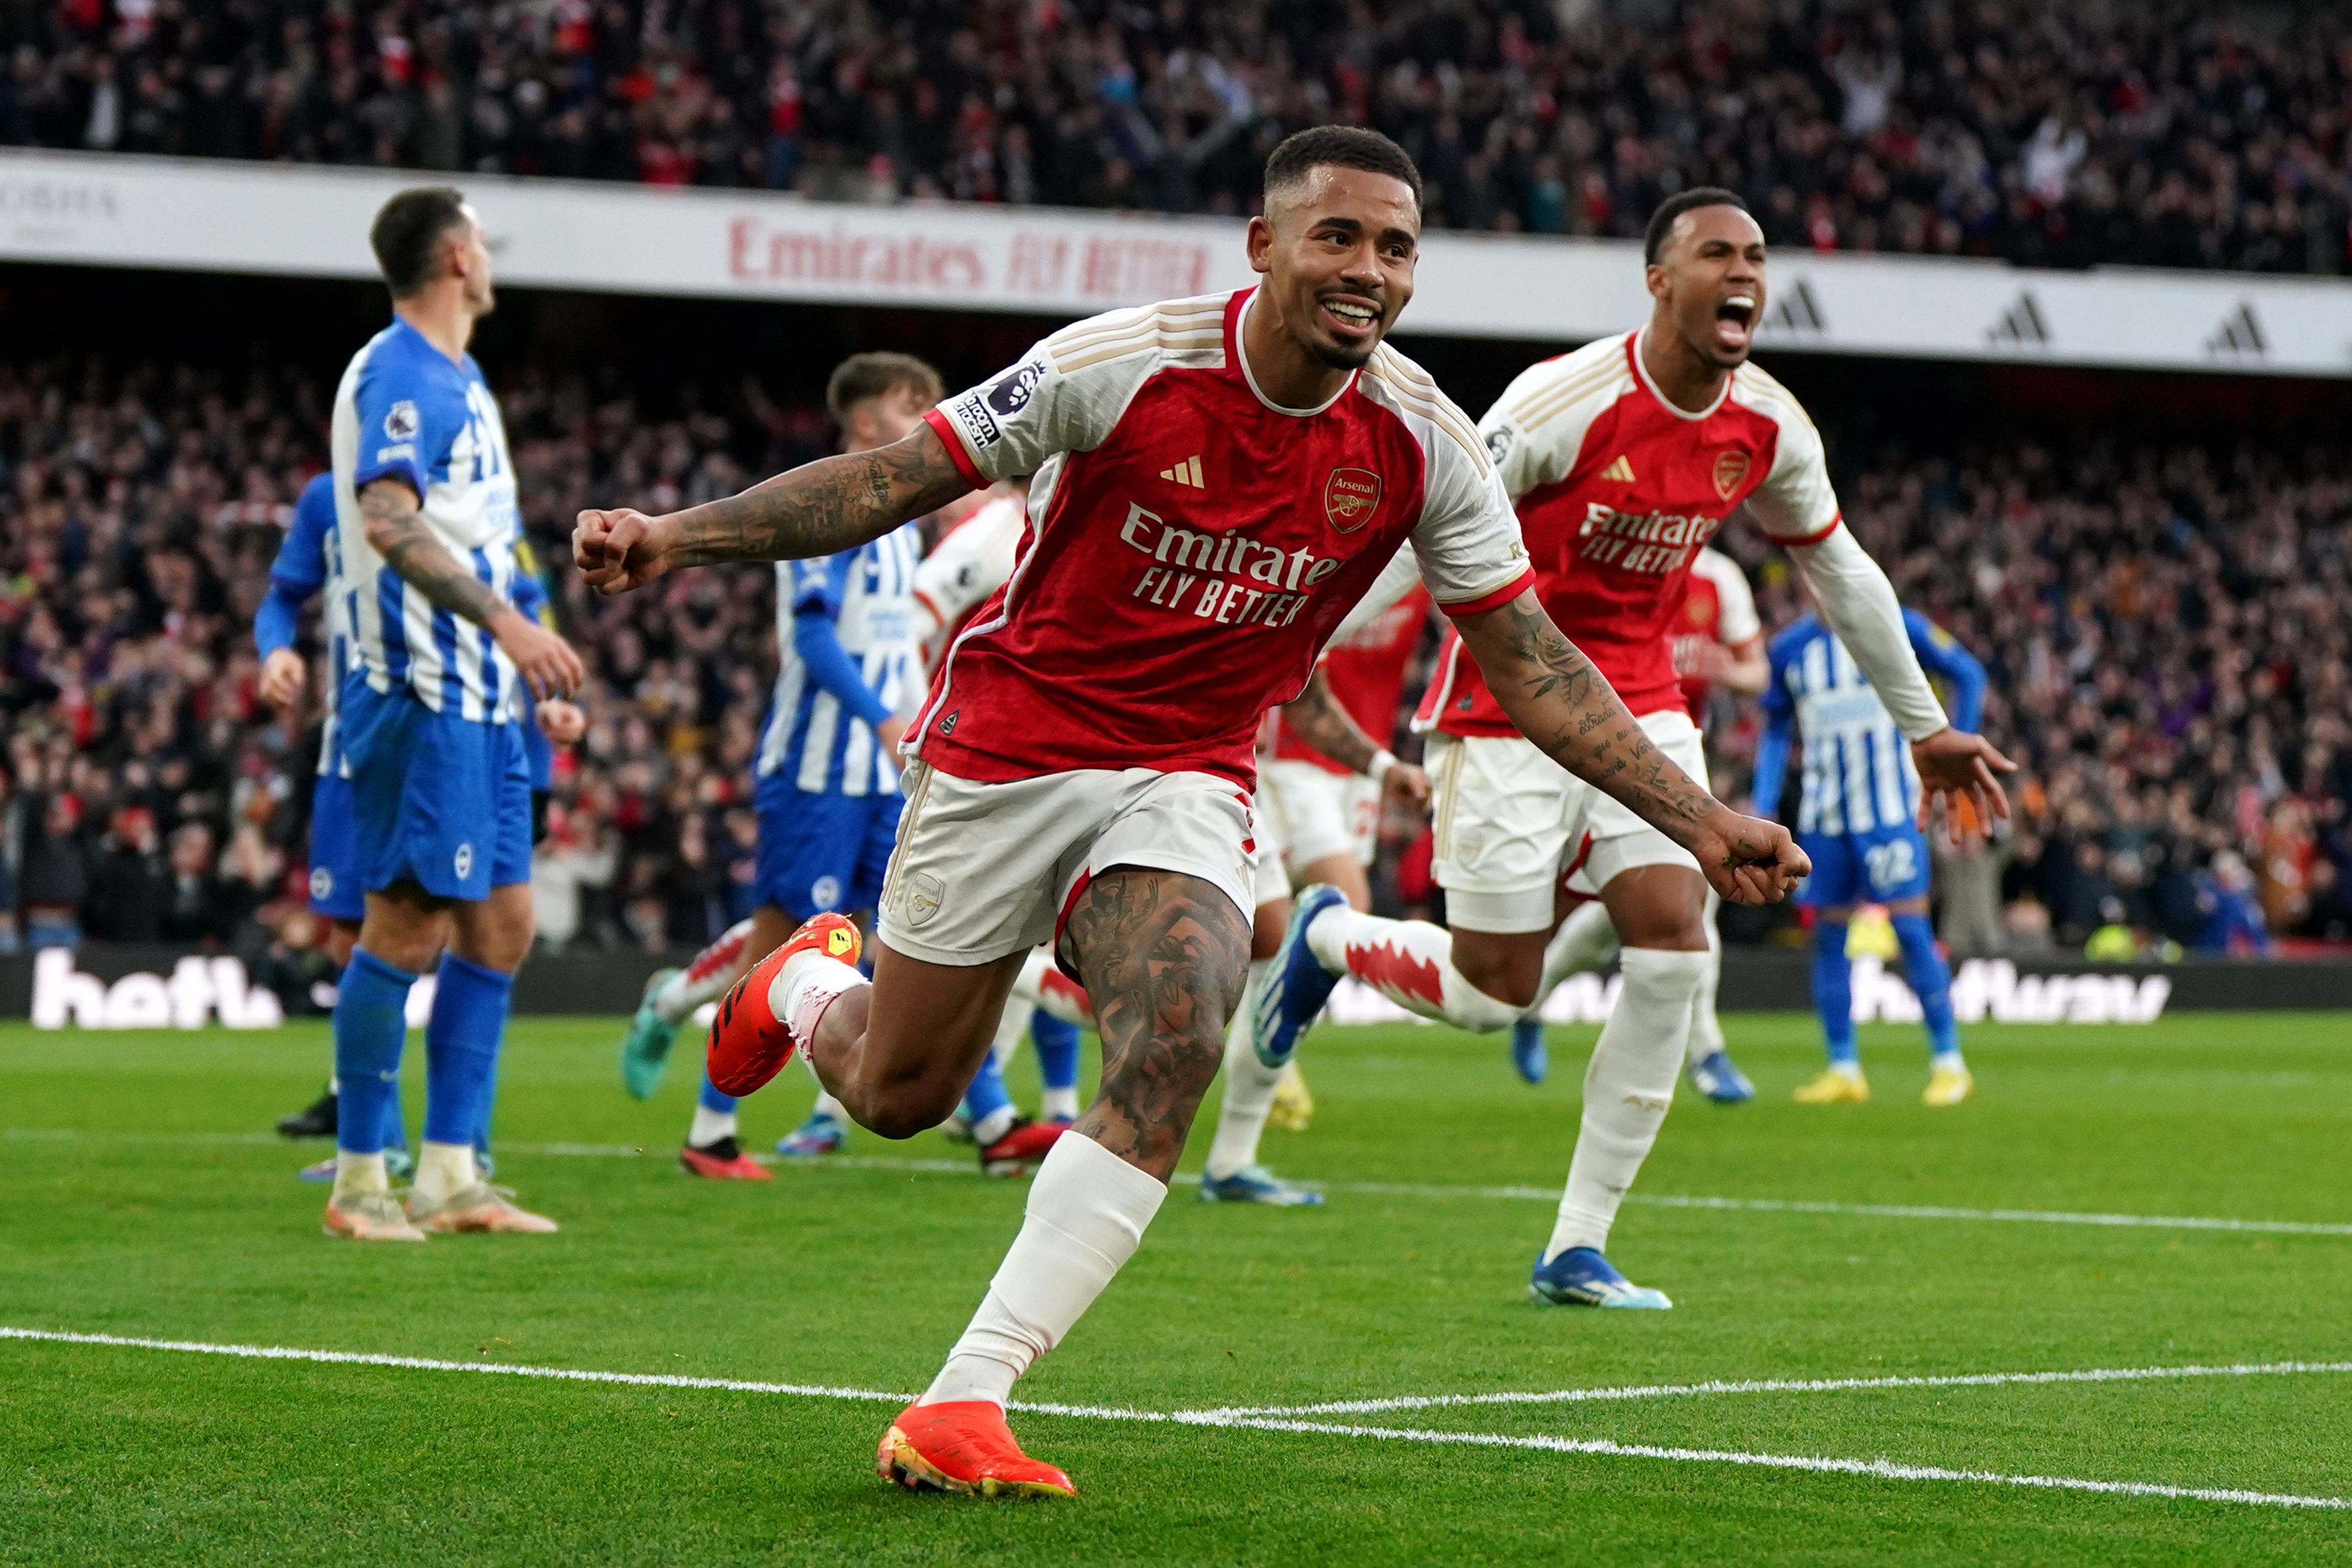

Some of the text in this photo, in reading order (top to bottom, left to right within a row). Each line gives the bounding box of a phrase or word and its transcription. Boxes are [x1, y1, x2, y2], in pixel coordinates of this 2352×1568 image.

[958, 408, 988, 449] racism
[969, 403, 995, 438] room
[1335, 478, 1374, 494] Arsenal
[1120, 501, 1338, 591] Emirate
[1133, 566, 1197, 609] FLY
[1194, 576, 1309, 627] BETTER
